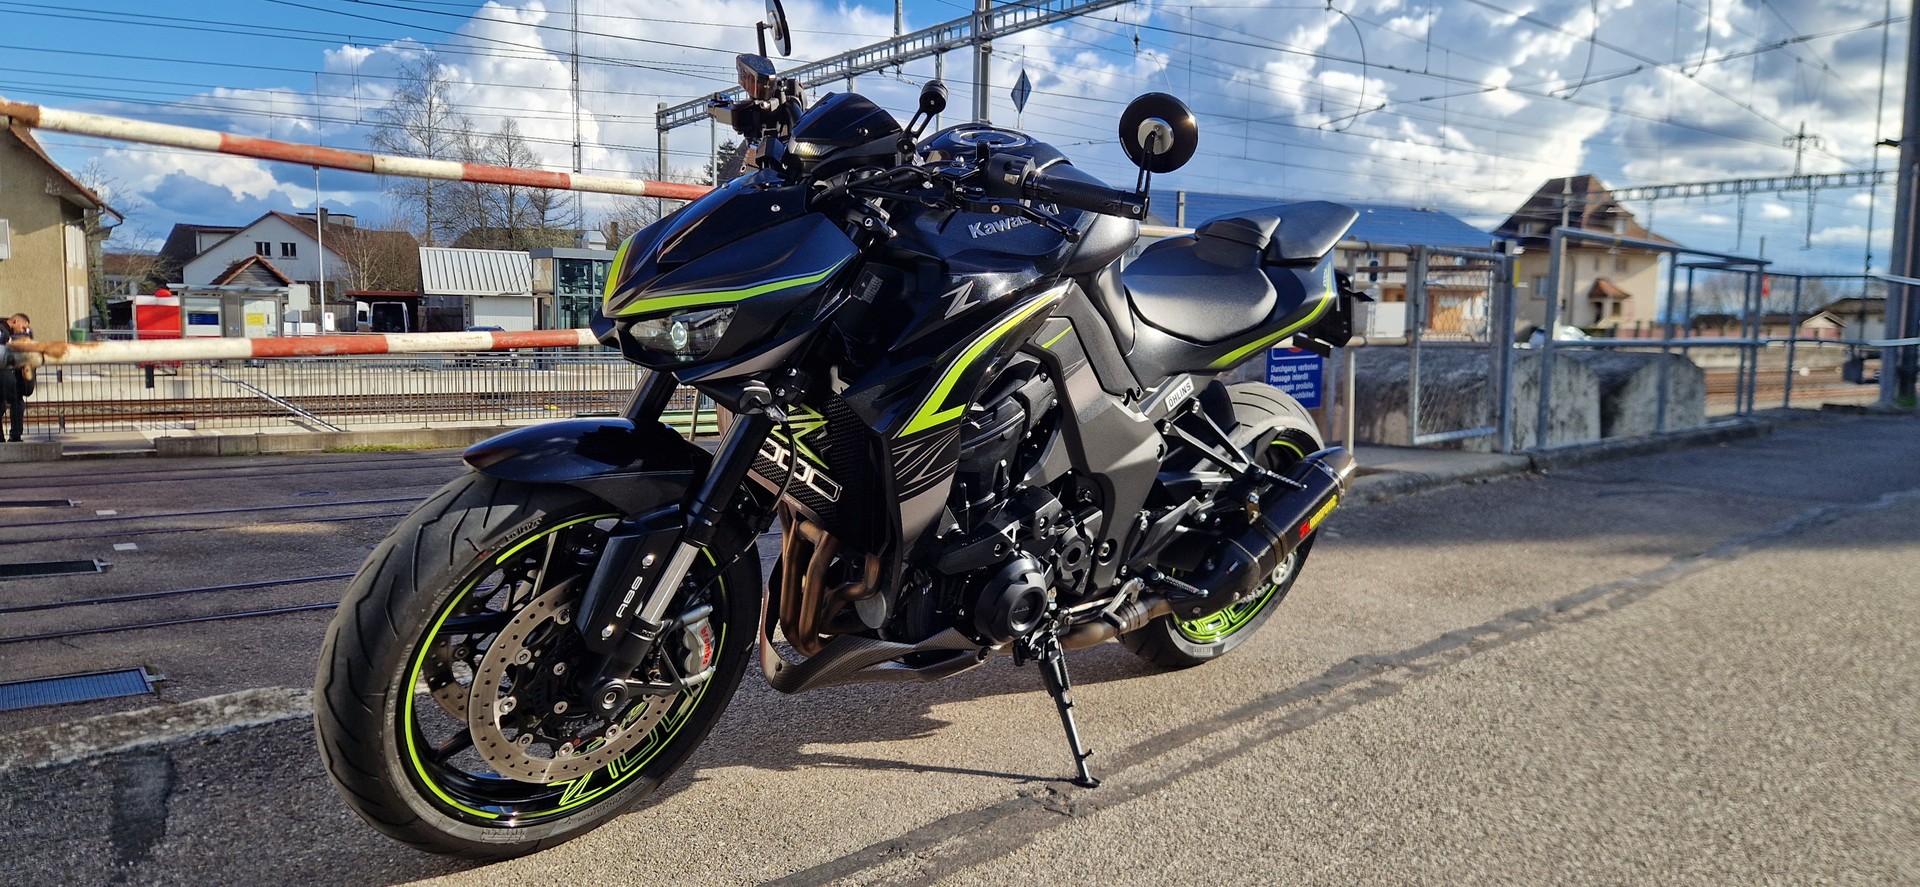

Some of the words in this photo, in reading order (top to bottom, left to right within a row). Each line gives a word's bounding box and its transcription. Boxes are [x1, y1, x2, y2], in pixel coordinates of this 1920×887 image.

[968, 203, 1060, 239] Kawaski
[1270, 365, 1297, 373] Durchgang
[1297, 363, 1319, 371] verboten
[1270, 374, 1291, 383] Passage
[1292, 372, 1309, 381] interdit
[615, 575, 643, 618] ABS
